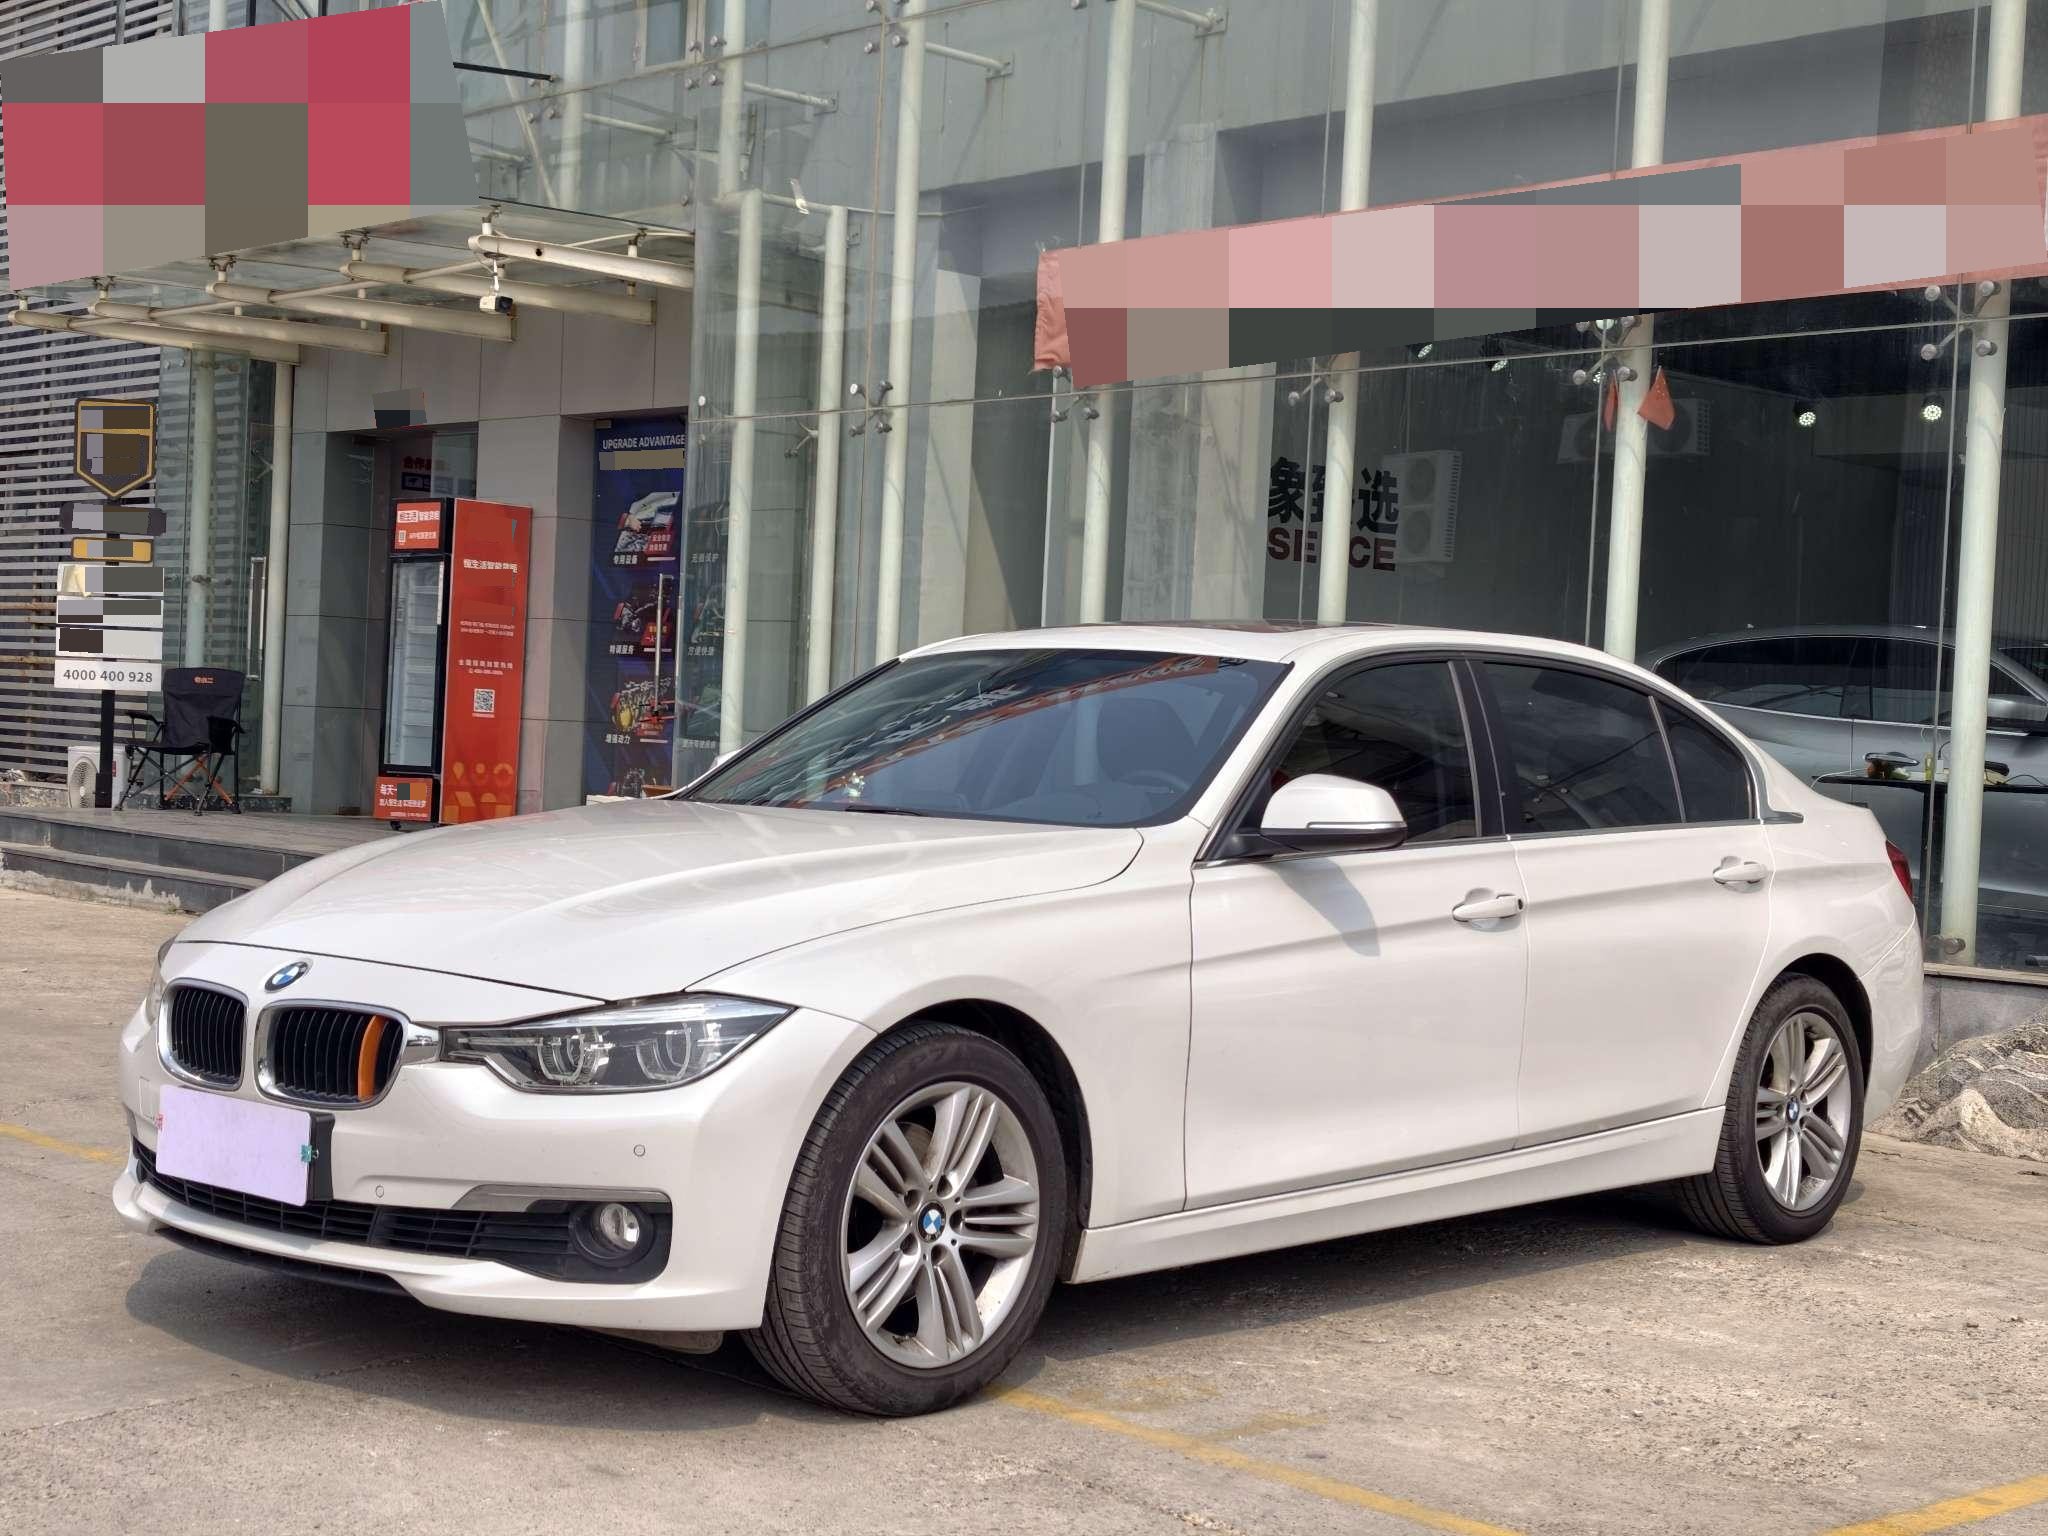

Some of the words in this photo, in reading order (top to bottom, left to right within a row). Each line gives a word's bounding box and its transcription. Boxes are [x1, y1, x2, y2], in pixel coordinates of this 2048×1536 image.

[602, 437, 638, 450] UPGRADE
[638, 434, 686, 448] ADVANTAGE
[63, 668, 96, 682] 4000
[100, 670, 126, 682] 400
[128, 670, 153, 683] 928
